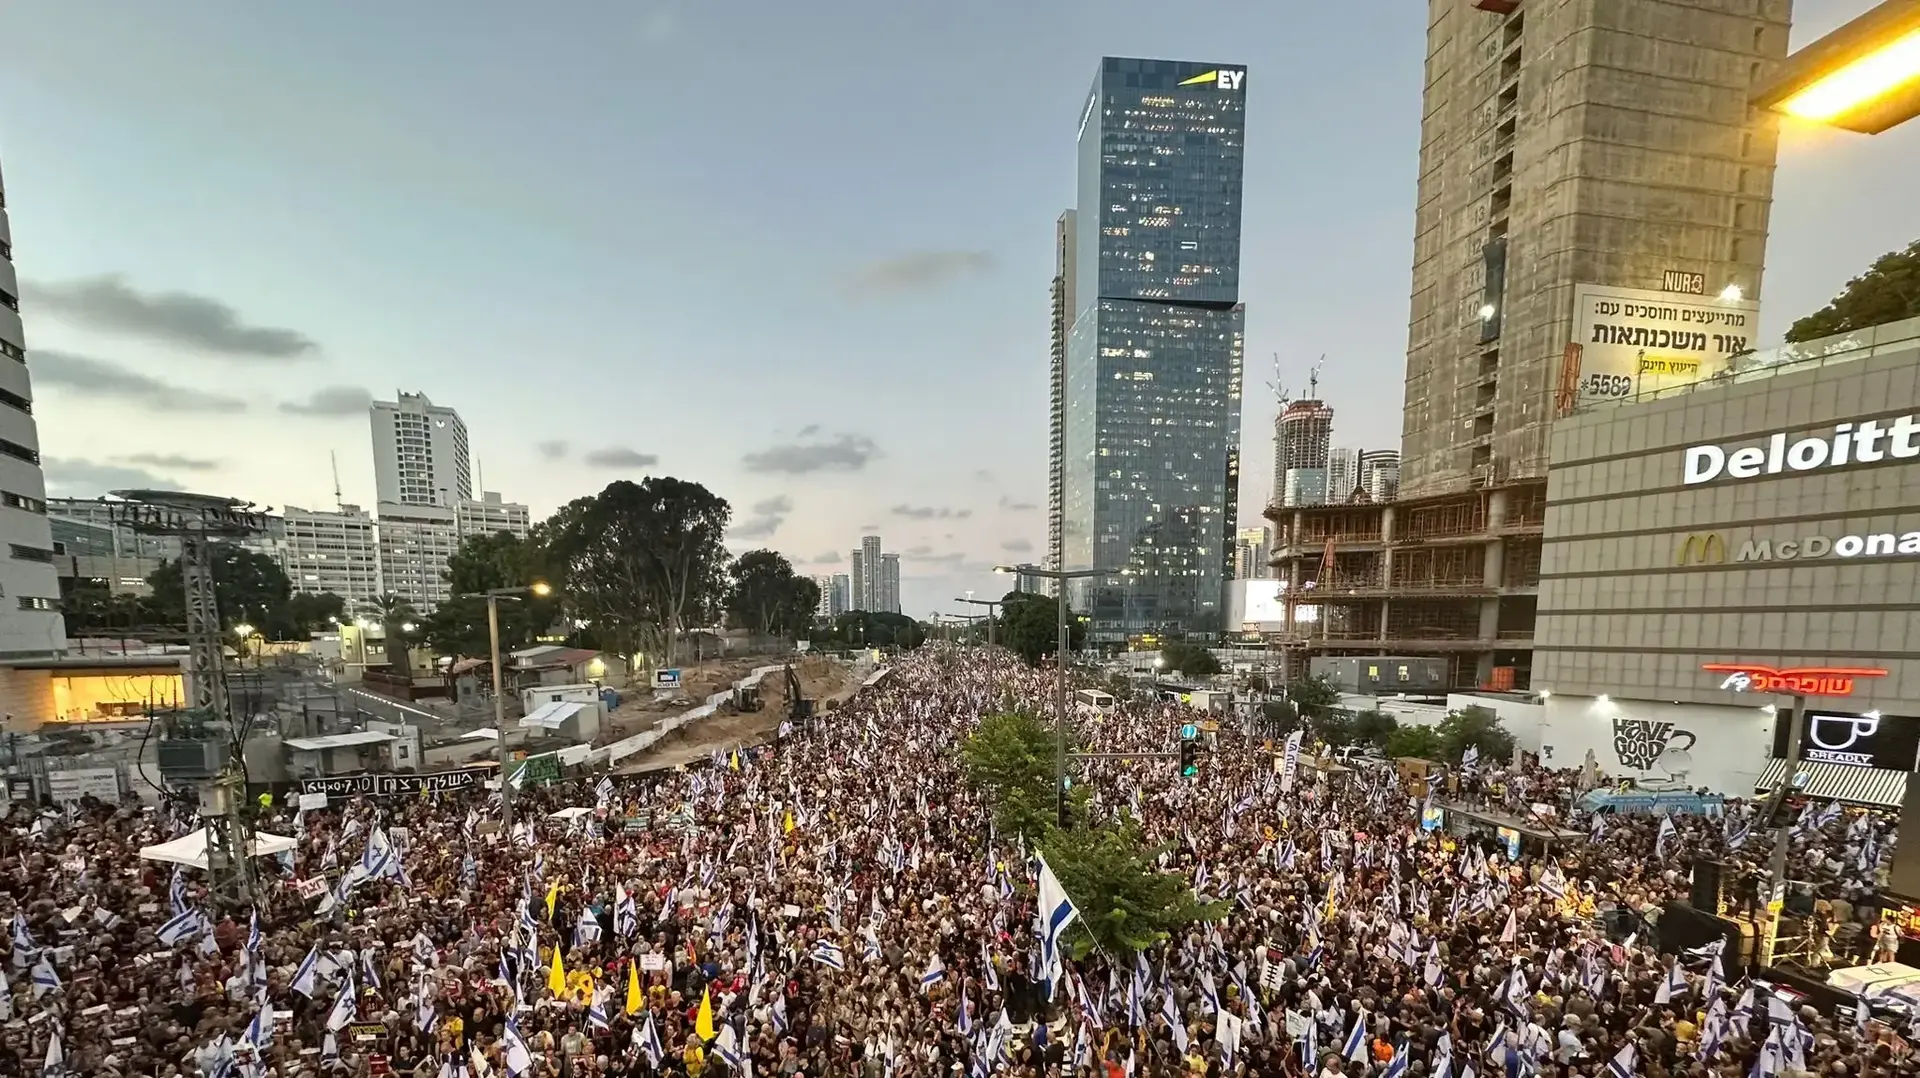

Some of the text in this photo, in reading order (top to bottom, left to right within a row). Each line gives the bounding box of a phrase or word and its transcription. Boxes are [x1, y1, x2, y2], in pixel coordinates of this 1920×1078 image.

[1218, 70, 1244, 90] EY
[1595, 301, 1745, 327] מתייעצים וחוסכים עם:
[1591, 323, 1747, 354] אור משכנתאות
[1752, 673, 1852, 694] שופרסל
[1614, 735, 1666, 758] GOOD
[1618, 753, 1658, 770] DAY
